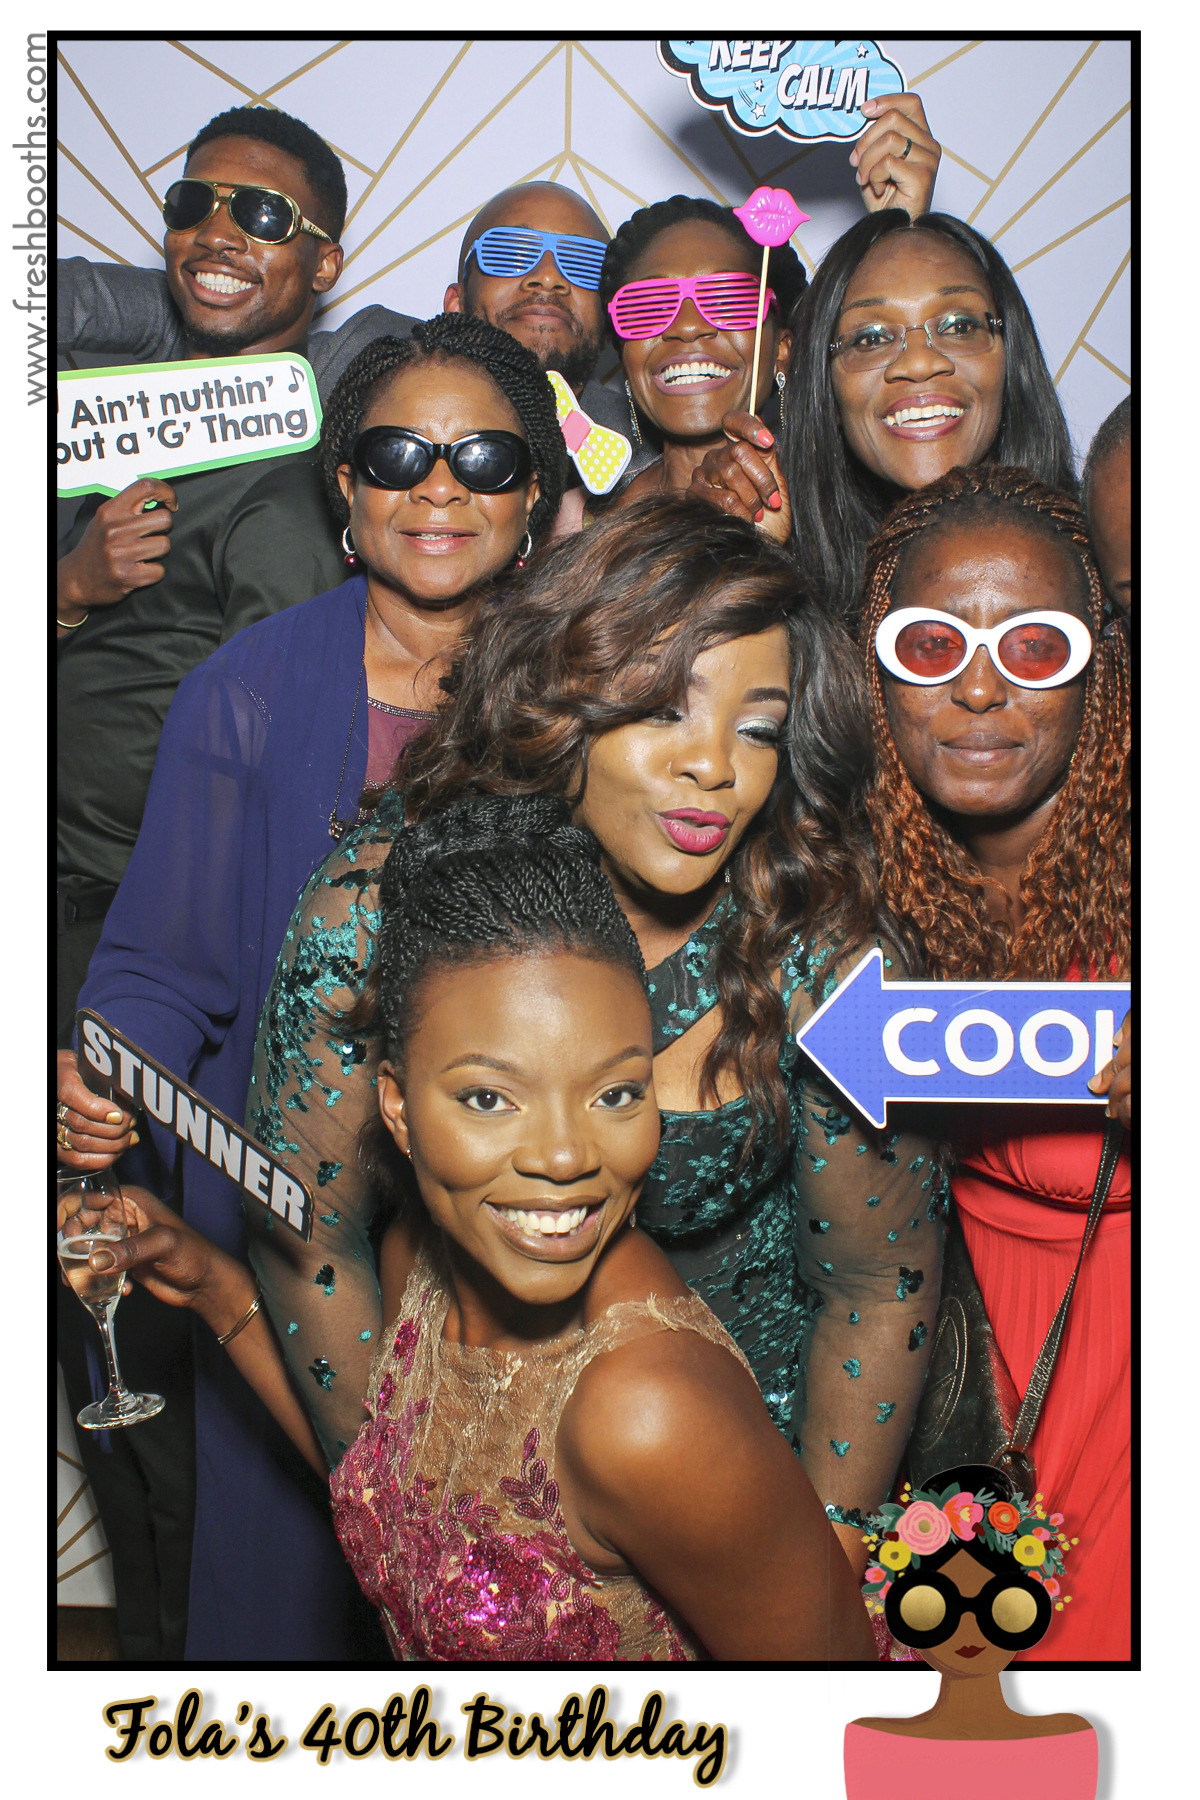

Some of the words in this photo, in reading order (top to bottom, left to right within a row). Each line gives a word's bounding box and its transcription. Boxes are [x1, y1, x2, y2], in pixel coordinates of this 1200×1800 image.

[707, 40, 795, 72] KEEP
[777, 63, 869, 113] CALM
[71, 390, 150, 429] Ain't
[159, 376, 274, 416] nuthin'
[116, 432, 140, 455] a
[200, 408, 308, 444] Thang
[83, 1019, 304, 1232] STUNNER
